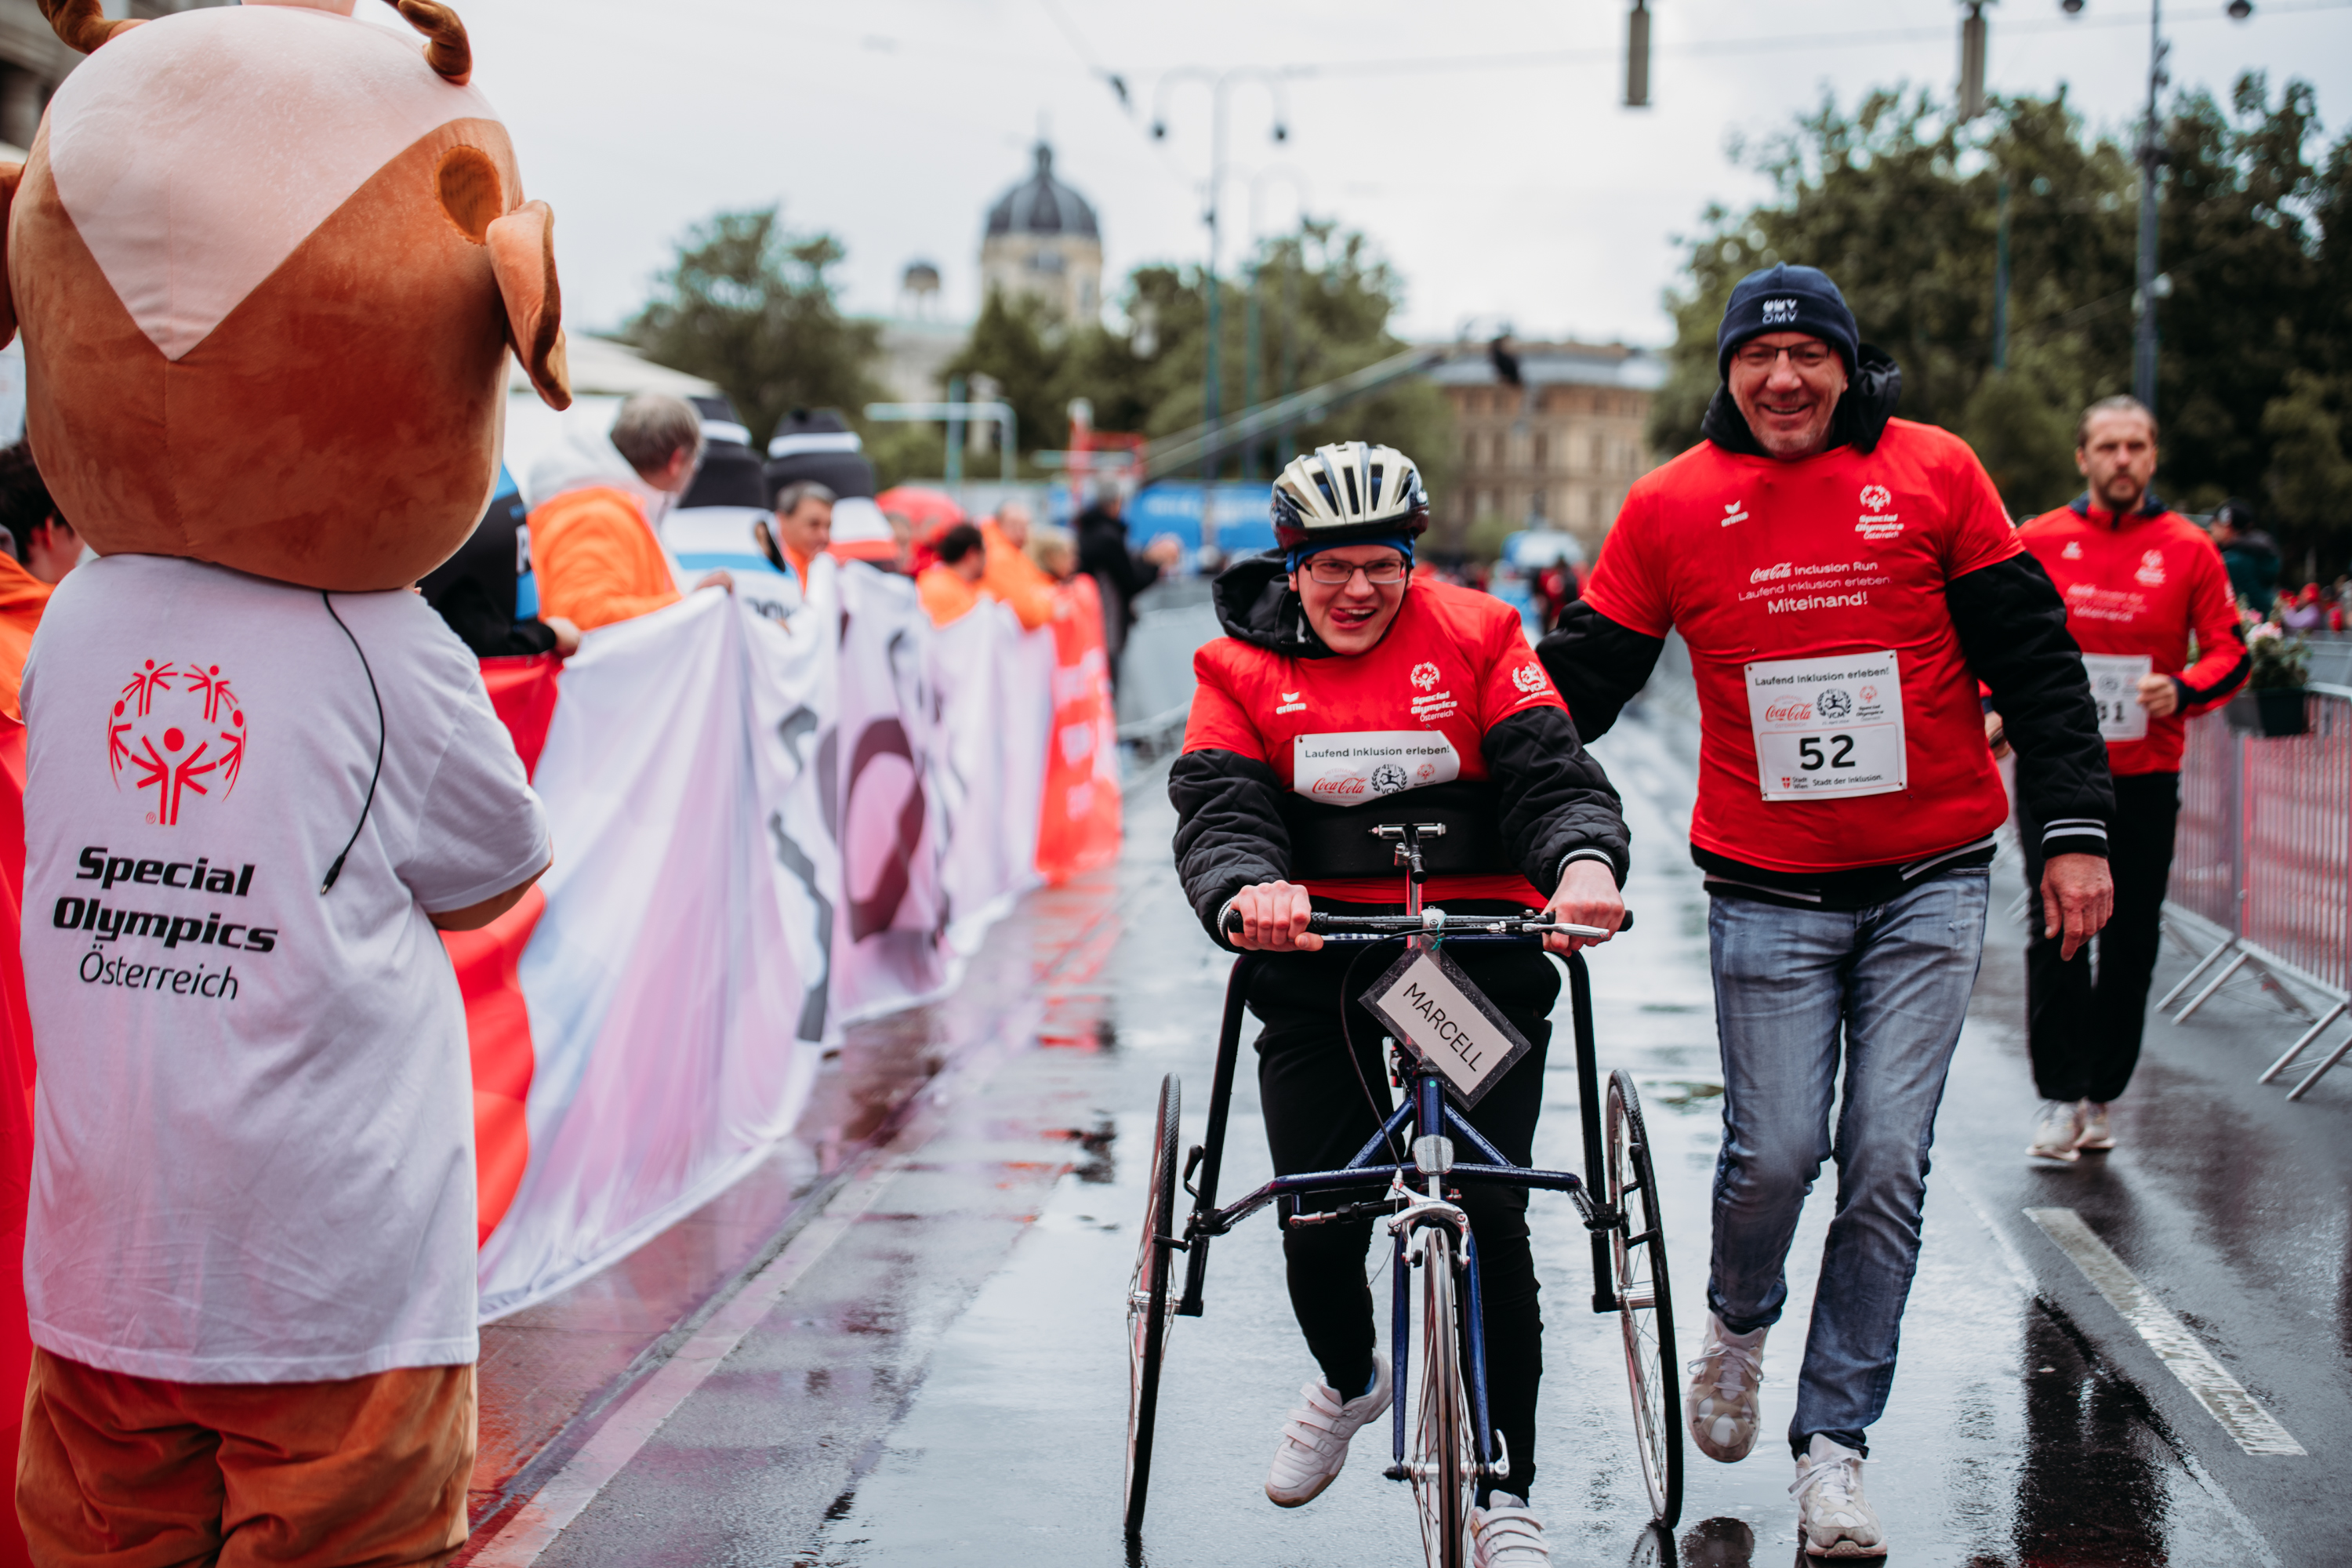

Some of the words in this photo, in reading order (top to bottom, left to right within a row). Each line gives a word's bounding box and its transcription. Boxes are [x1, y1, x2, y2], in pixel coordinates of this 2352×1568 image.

[1762, 310, 1798, 325] OMV
[1721, 511, 1749, 528] erima
[1859, 514, 1898, 524] Special
[1855, 523, 1904, 534] Olympics
[1795, 562, 1850, 576] Inclusion
[1853, 561, 1878, 572] Run
[1737, 583, 1785, 601] Laufend
[1788, 579, 1842, 592] Inklusion
[1767, 590, 1868, 615] Miteinand!
[1755, 675, 1794, 686] Laufend
[1797, 671, 1844, 684] Inklusion
[1846, 666, 1889, 680] erleben!
[1412, 691, 1450, 706] Special
[1276, 702, 1307, 715] erima
[1410, 700, 1457, 714] Olympics
[1420, 710, 1454, 722] Österreich
[1305, 748, 1349, 758] Laufend
[1353, 746, 1403, 757] Inklusion
[1405, 744, 1450, 755] erleben!
[1799, 734, 1856, 771] 52
[1813, 778, 1832, 786] Stadt
[1848, 774, 1883, 783] Inklusion.
[76, 845, 256, 897] Special
[53, 896, 278, 953] Olympics
[79, 943, 238, 1000] Österreich
[1403, 982, 1482, 1072] MARCELL
